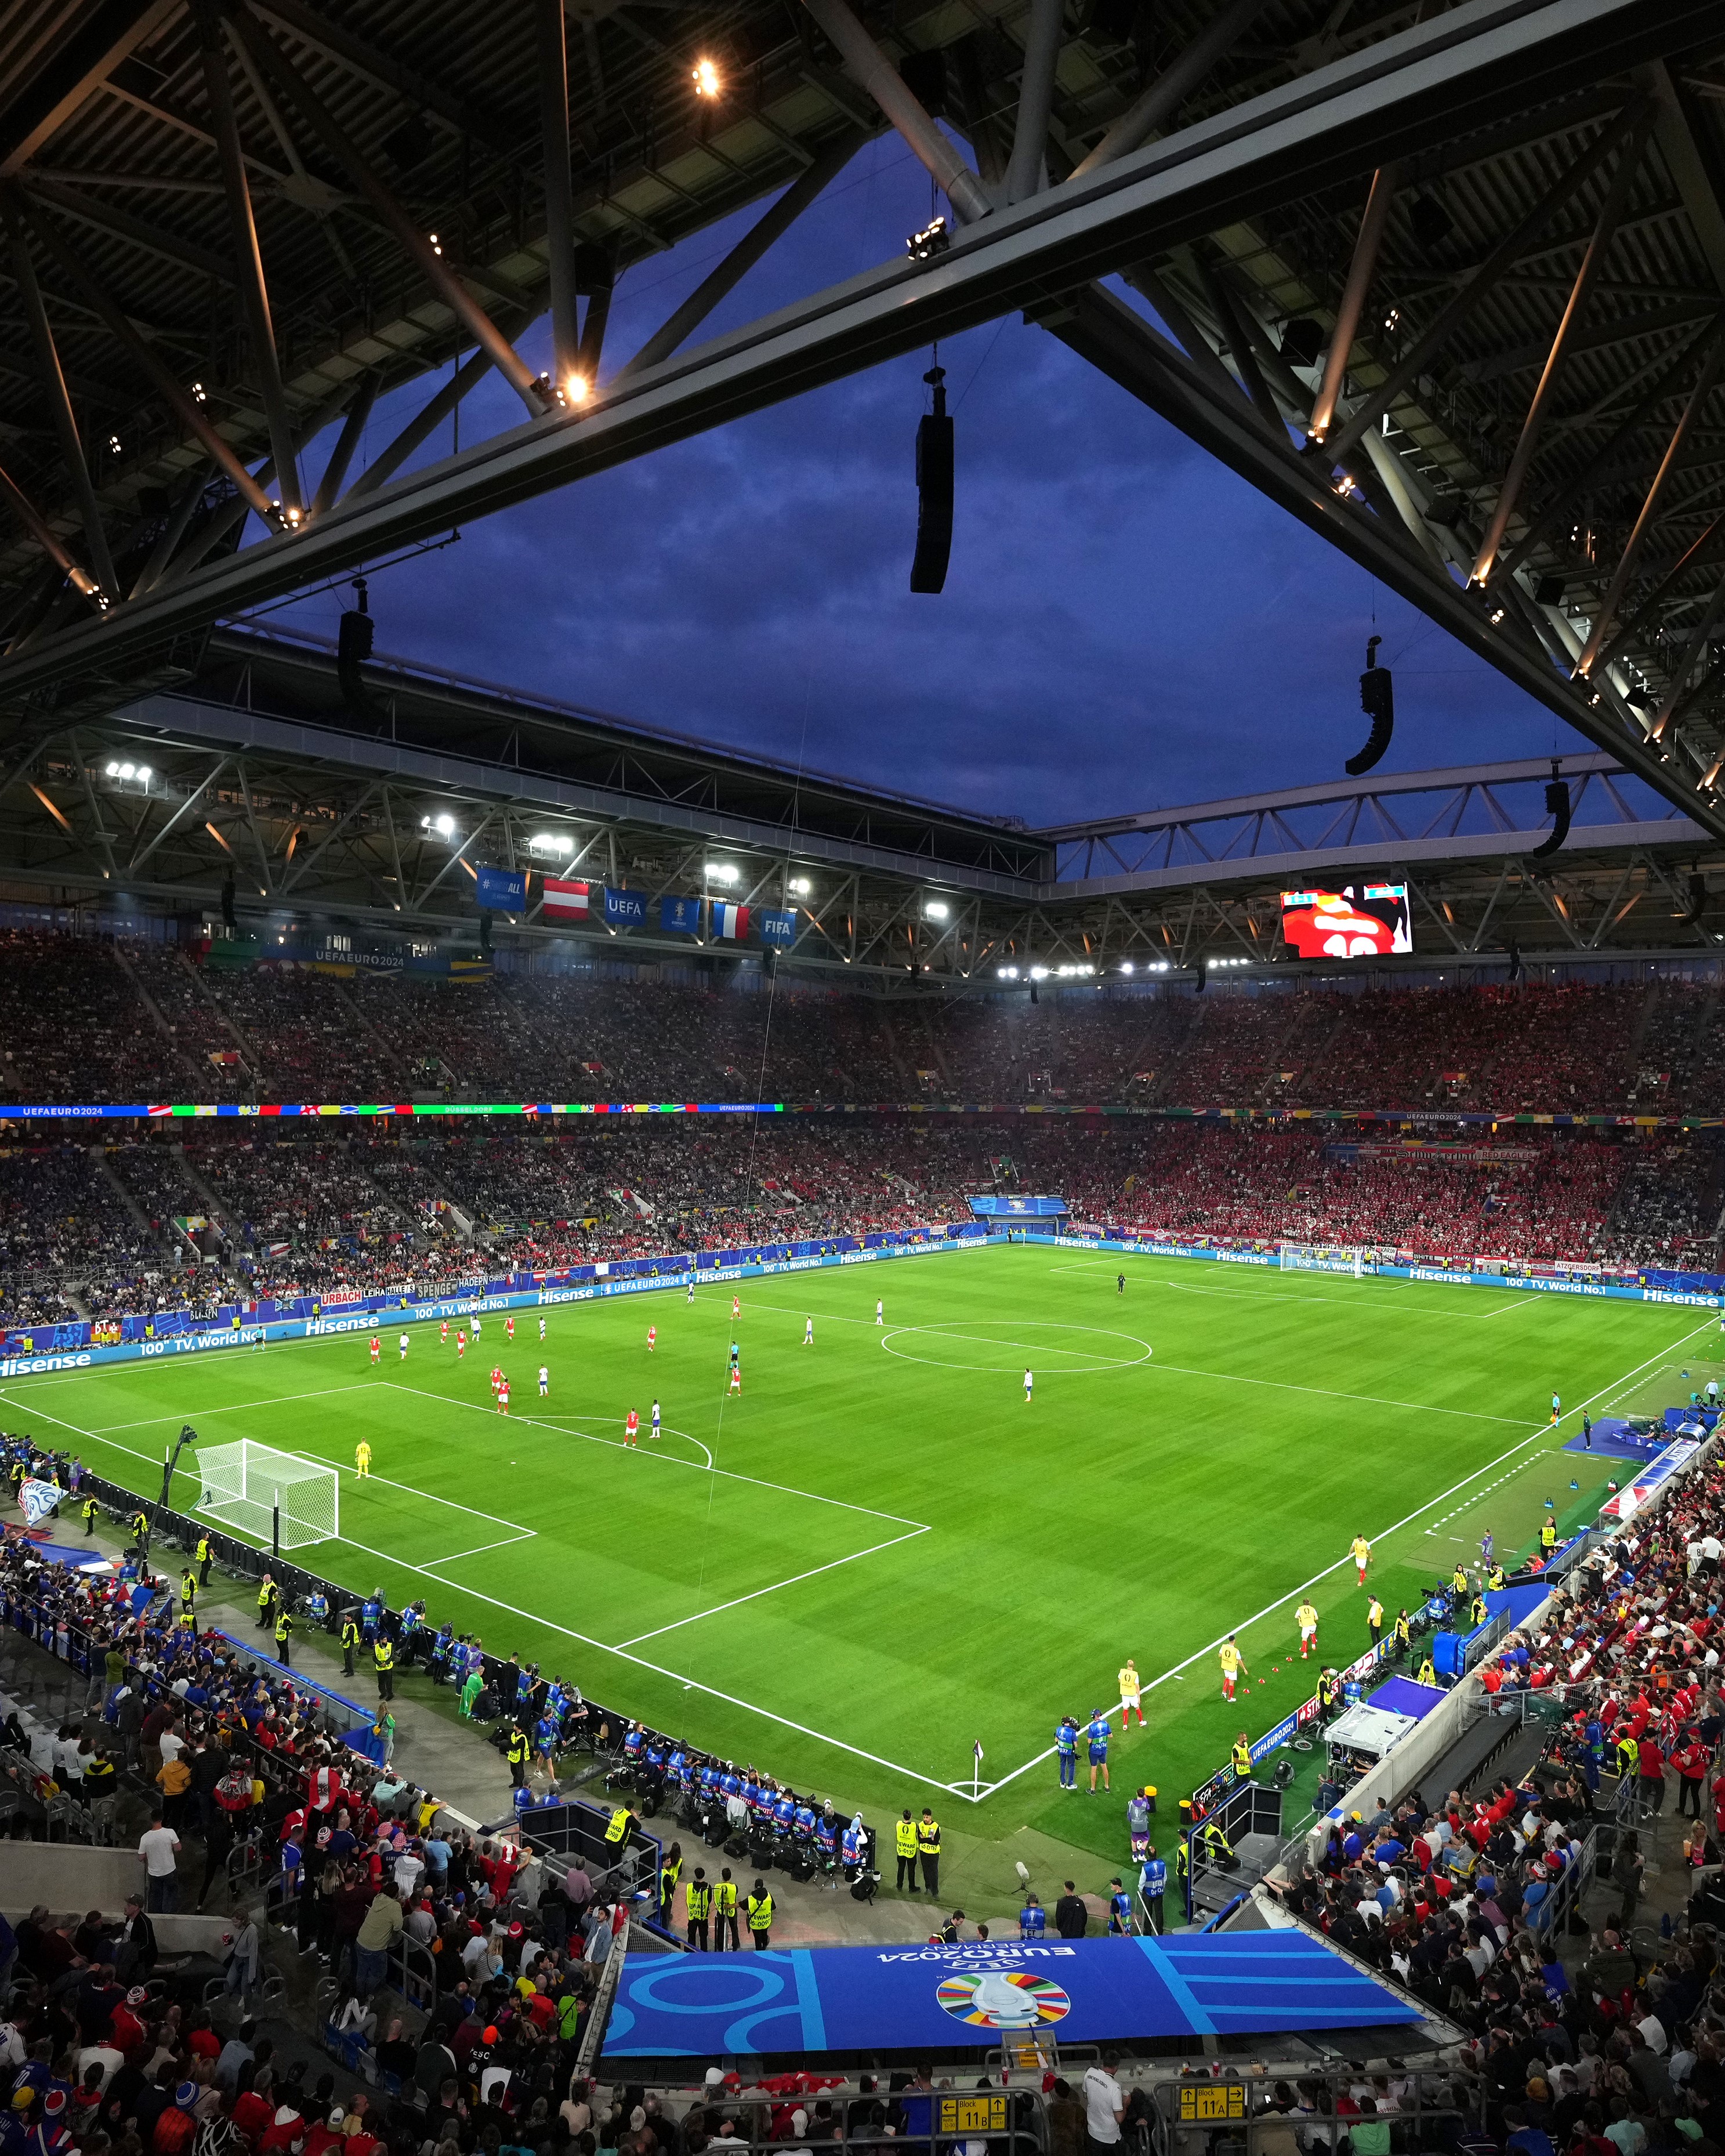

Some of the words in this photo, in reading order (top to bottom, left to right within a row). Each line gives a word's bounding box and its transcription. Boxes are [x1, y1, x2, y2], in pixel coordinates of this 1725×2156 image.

[609, 899, 641, 916] UEFA
[765, 920, 791, 935] FIFA
[1078, 1223, 1104, 1234] RATINGE
[957, 1238, 987, 1248] Hisense
[1054, 1235, 1099, 1249] Hisense
[894, 1246, 905, 1256] 100"
[907, 1246, 915, 1254] TV,
[916, 1244, 931, 1253] World
[1140, 1245, 1151, 1254] TV,
[1151, 1246, 1175, 1255] World
[1176, 1248, 1191, 1256] No.1
[840, 1252, 877, 1264] Hisense
[1216, 1251, 1269, 1265] Hisense
[763, 1263, 777, 1273] 100"
[779, 1262, 789, 1272] TV,
[789, 1260, 809, 1269] World
[810, 1258, 822, 1266] No.1
[1557, 1262, 1600, 1271] ATZGERSDORF
[696, 1269, 742, 1283] Hisense
[1409, 1268, 1472, 1284] Hisense
[386, 1286, 405, 1295] HALLE
[418, 1282, 451, 1298] SPENGE
[1505, 1277, 1527, 1287] 100"
[1530, 1281, 1547, 1291] TV,
[1548, 1282, 1582, 1293] World
[1584, 1286, 1606, 1294] No.1
[322, 1290, 361, 1305] URBACH
[363, 1288, 385, 1298] LEIHA
[538, 1288, 594, 1305] Hisense
[1643, 1289, 1719, 1307] Hisense
[415, 1306, 437, 1319] 100"
[441, 1304, 456, 1319] TV,
[490, 1299, 509, 1309] No.1
[306, 1316, 379, 1336] Hisense
[140, 1340, 170, 1356] 100"
[175, 1337, 195, 1352] TV,
[198, 1332, 239, 1349] World
[1697, 1548, 1701, 1556] 8
[922, 1943, 1025, 1951] GERMANY
[876, 1947, 1076, 1963] EURO2024
[952, 1959, 1020, 1969] UEFA
[1198, 2088, 1215, 2096] Block
[959, 2100, 977, 2108] Block
